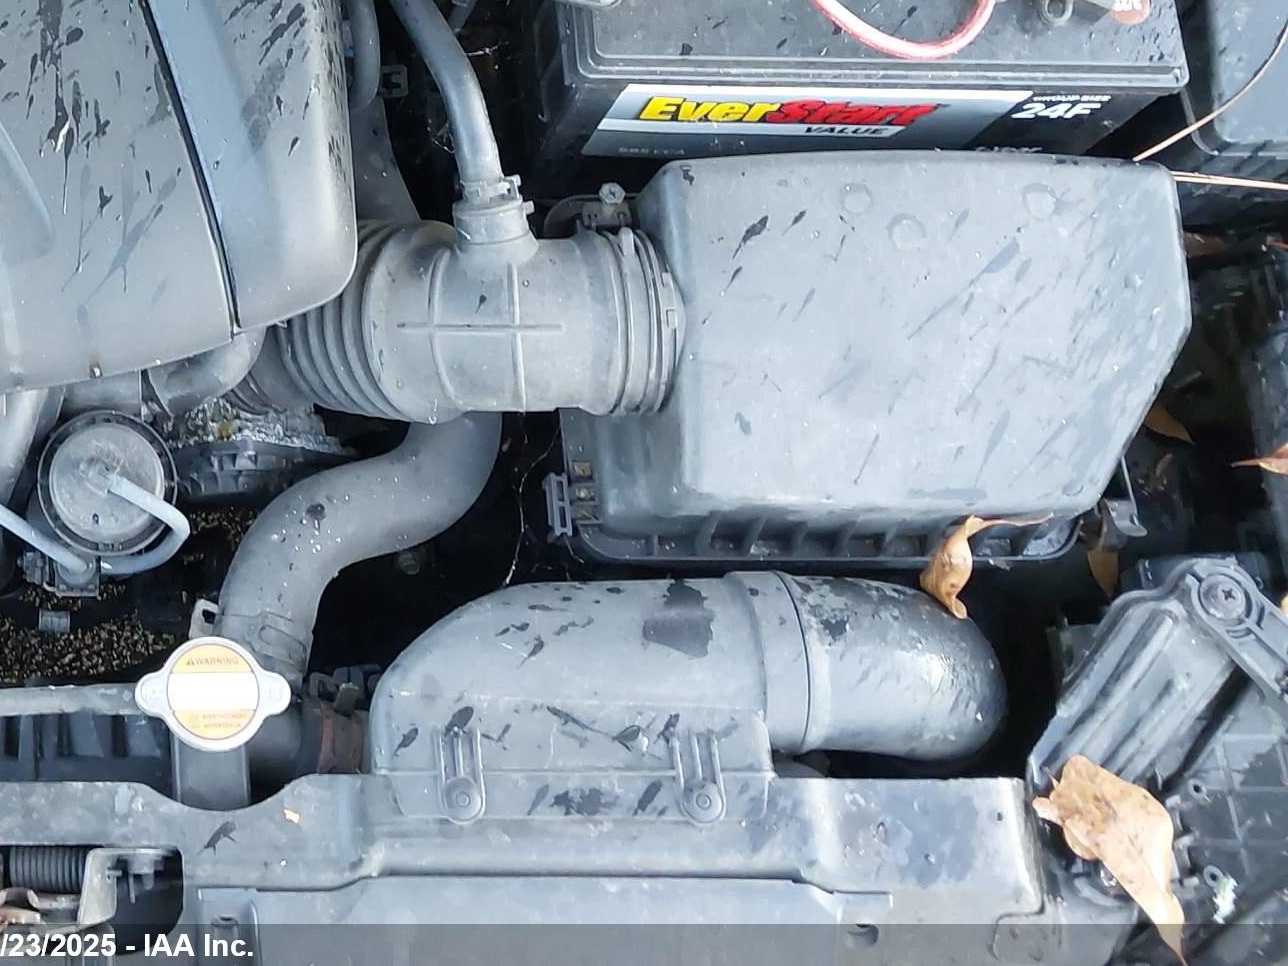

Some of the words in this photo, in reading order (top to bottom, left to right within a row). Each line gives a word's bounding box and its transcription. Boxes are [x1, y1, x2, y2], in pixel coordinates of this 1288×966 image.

[638, 96, 942, 125] EverStart
[1011, 102, 1102, 120] 24F
[804, 126, 889, 136] VALUE
[195, 656, 239, 667] WARNING
